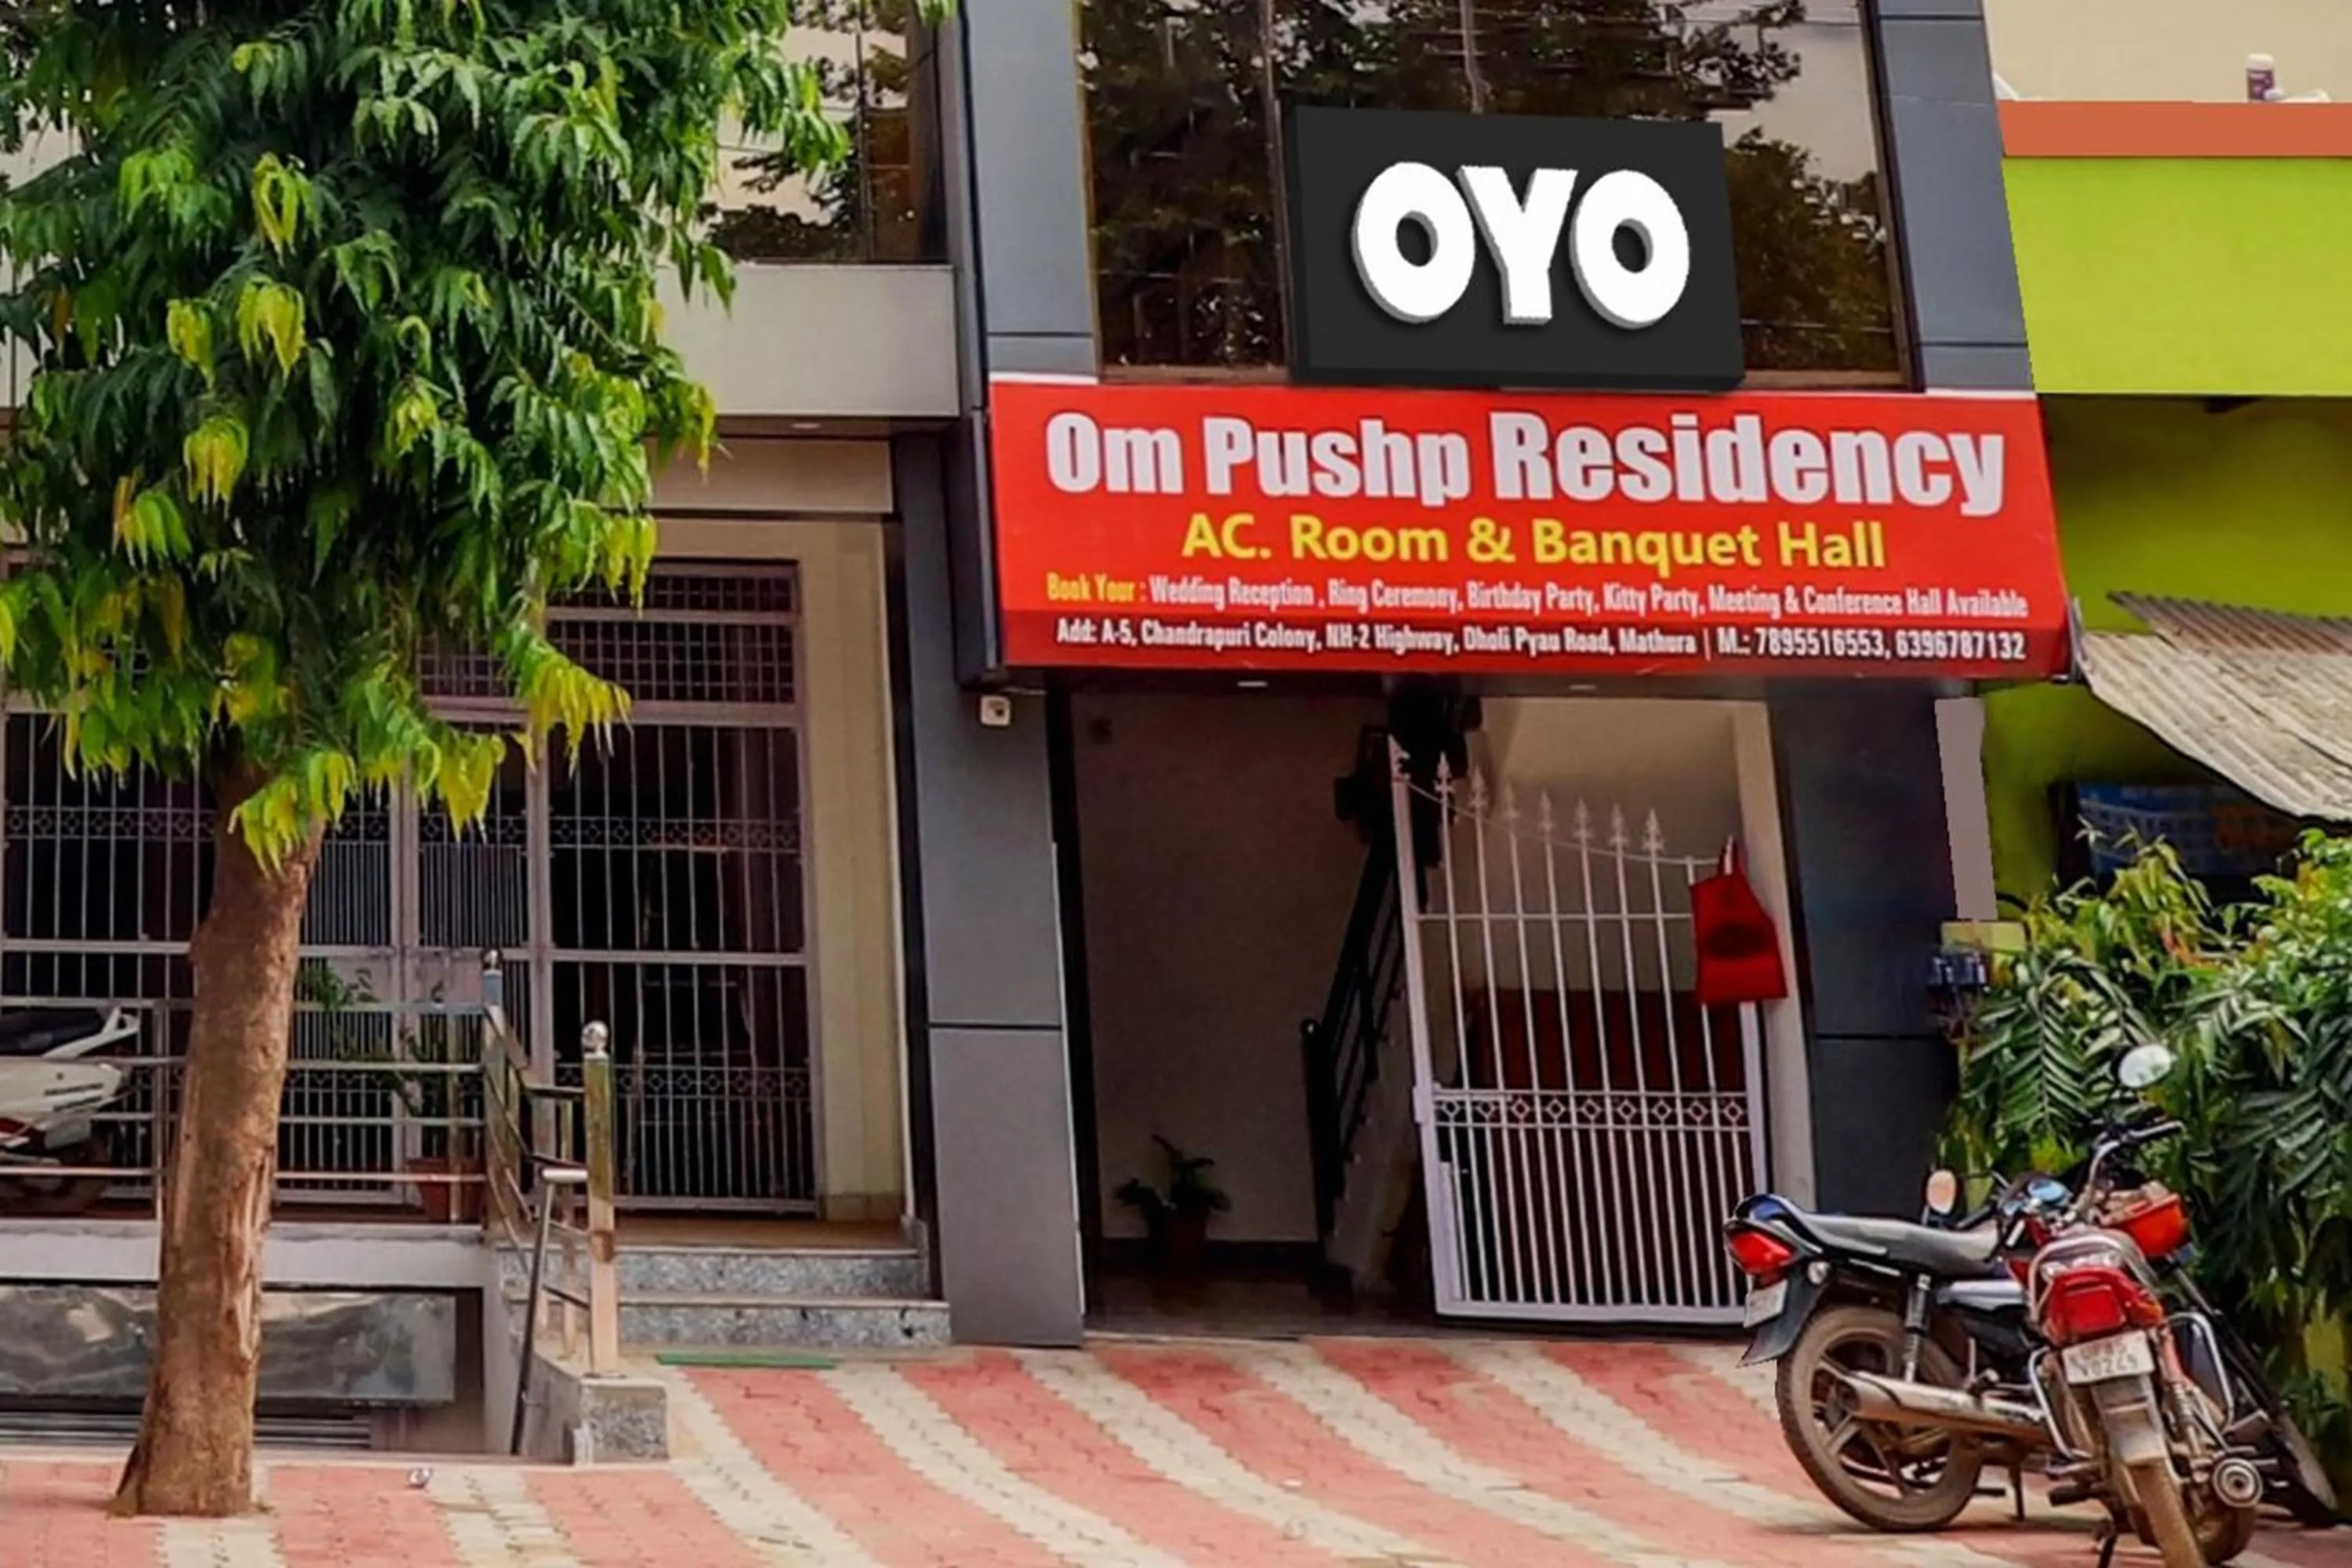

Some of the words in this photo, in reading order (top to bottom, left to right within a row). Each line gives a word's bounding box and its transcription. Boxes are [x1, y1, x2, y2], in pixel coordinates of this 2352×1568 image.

[1351, 162, 1690, 329] OYO
[1046, 412, 1184, 495] Om
[1203, 416, 1472, 506] Pushp
[1490, 411, 2005, 517] Residency
[1181, 514, 1272, 560] AC.
[1290, 514, 1450, 561] Room
[1466, 517, 1516, 562] &
[1531, 518, 1762, 578] Banquet
[1777, 521, 1886, 568] Hall
[1047, 572, 1091, 601] Book
[1094, 573, 1134, 601] Your
[1148, 575, 1225, 612] Wedding
[1228, 576, 1314, 612] Reception
[1328, 578, 1369, 615] Ring
[1372, 579, 1464, 615] Ceremony,
[1467, 580, 1542, 616] Birthday
[1545, 581, 1600, 617] Party,
[1602, 582, 1646, 617] Kitty
[1650, 583, 1705, 619] Party,
[1708, 584, 1780, 620] Meeting
[1784, 585, 1801, 614] &
[1804, 585, 1903, 615] Conference
[1905, 587, 1943, 616] Hall
[1947, 587, 2029, 618] Available
[1057, 617, 1097, 643] Add:
[1102, 618, 1137, 647] A-5,
[1141, 619, 1250, 652] Chandrapuri
[1255, 622, 1323, 654] Colony,
[1325, 623, 1370, 649] NH-2
[1374, 624, 1460, 656] Highway,
[1463, 626, 1511, 652] Dholi
[1515, 626, 1561, 657] Pyau
[1563, 626, 1615, 656] Road,
[1618, 627, 1697, 655] Mathura
[1755, 627, 1892, 660] 7895516553,
[1895, 630, 2027, 660] 6396787132
